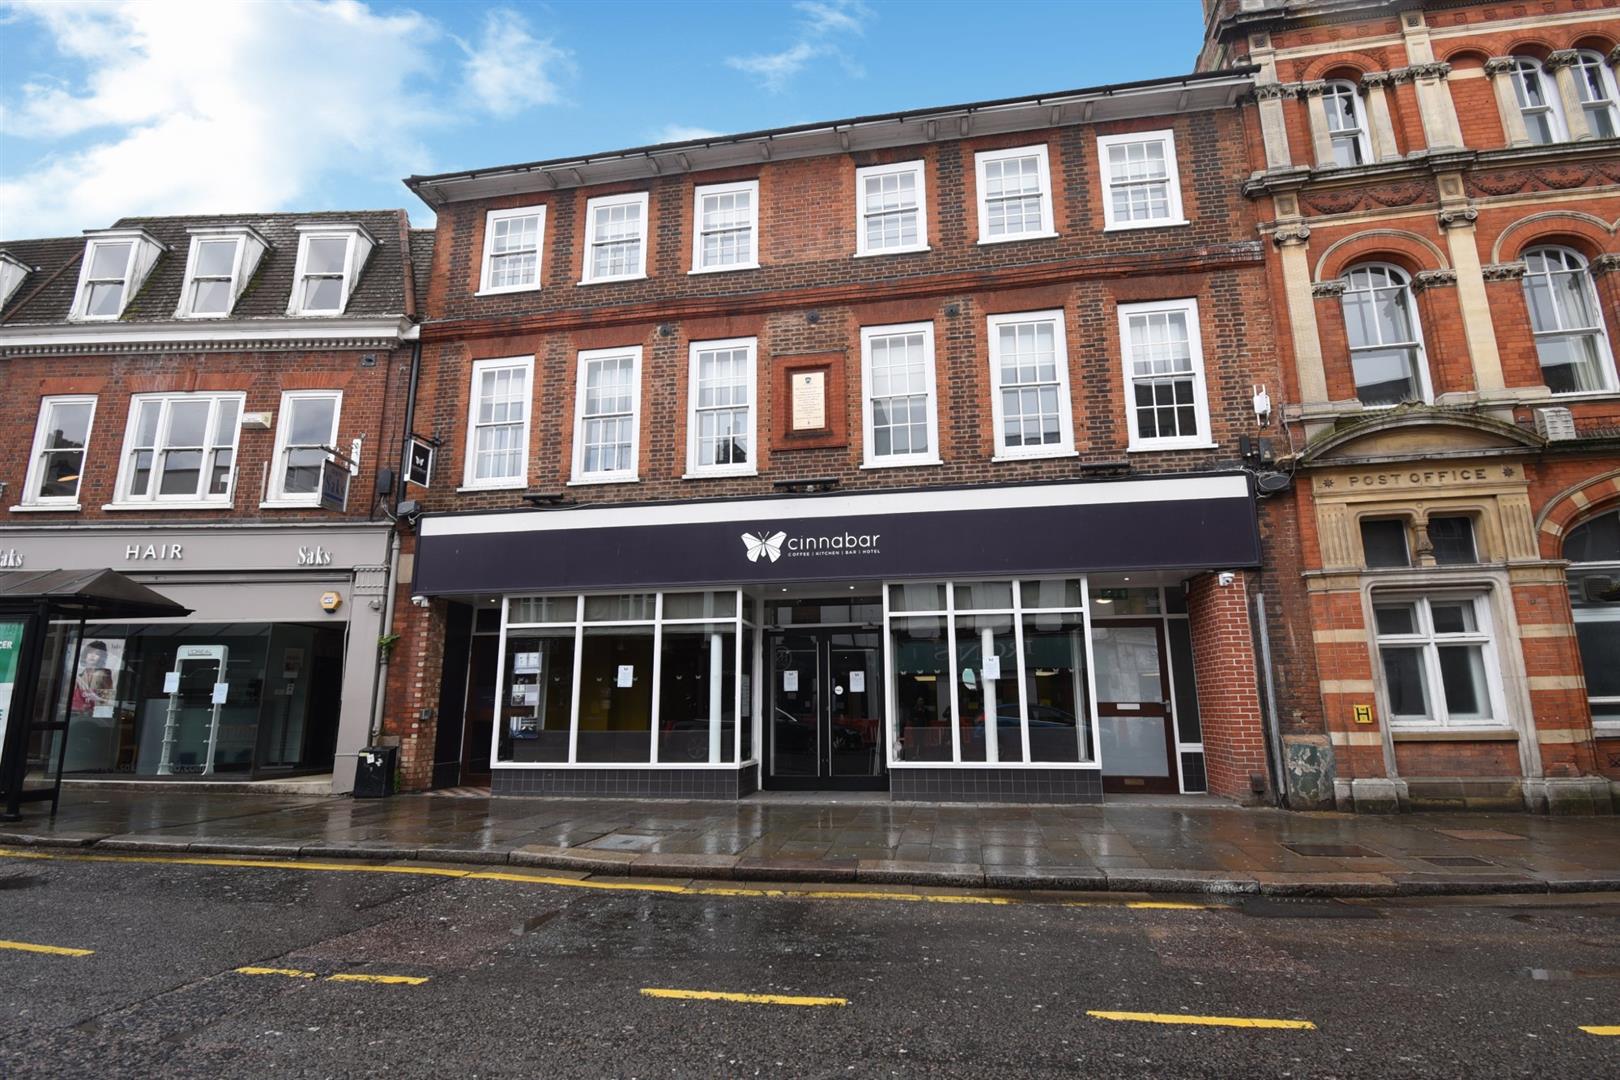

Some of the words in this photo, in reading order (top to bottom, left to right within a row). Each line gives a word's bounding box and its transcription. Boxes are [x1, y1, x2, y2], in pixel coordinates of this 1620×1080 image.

[1348, 473, 1402, 487] POST
[1408, 468, 1487, 484] OFFICE
[787, 531, 880, 550] cinnabar
[0, 548, 23, 567] aks
[125, 543, 182, 560] HAIR
[297, 545, 331, 565] Saks
[1356, 706, 1370, 721] H
